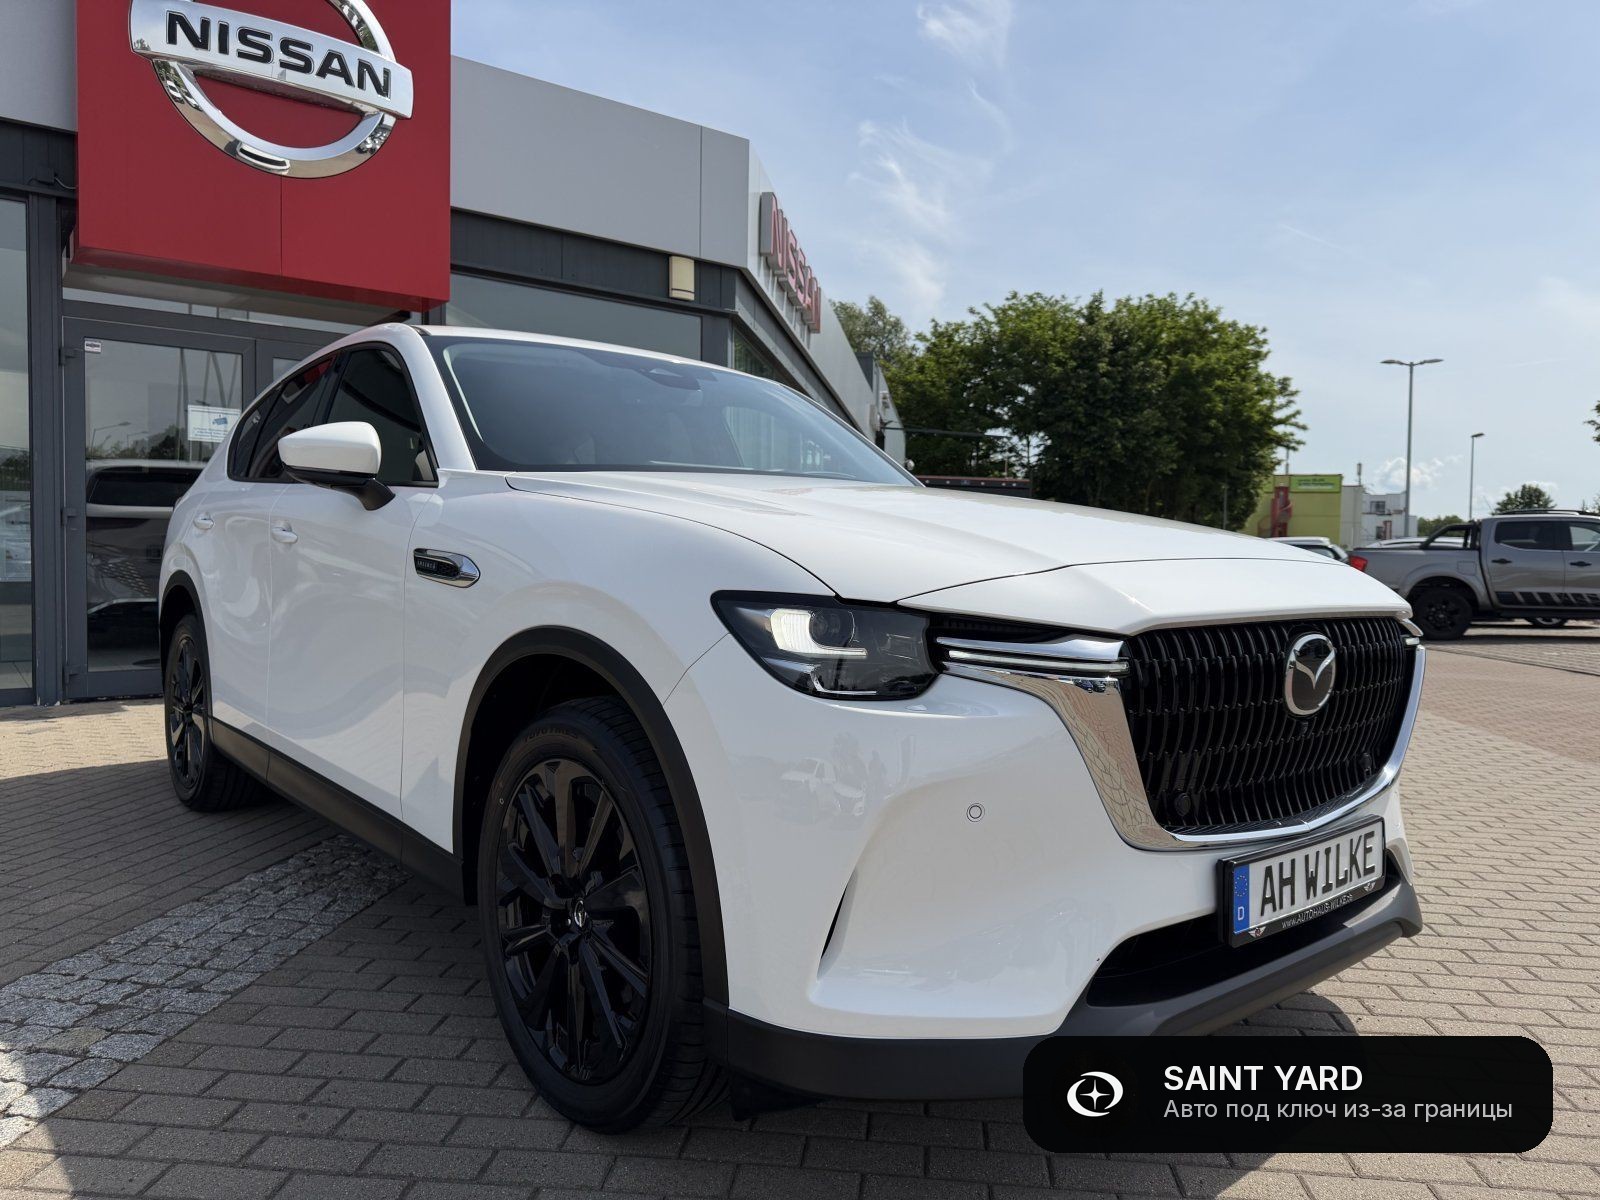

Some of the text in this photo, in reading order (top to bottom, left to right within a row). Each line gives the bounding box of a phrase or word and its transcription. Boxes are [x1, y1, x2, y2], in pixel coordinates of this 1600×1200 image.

[166, 10, 391, 100] NISSAN
[766, 192, 821, 333] NISSAN
[1237, 906, 1245, 921] D
[1260, 830, 1376, 917] AH WILKE
